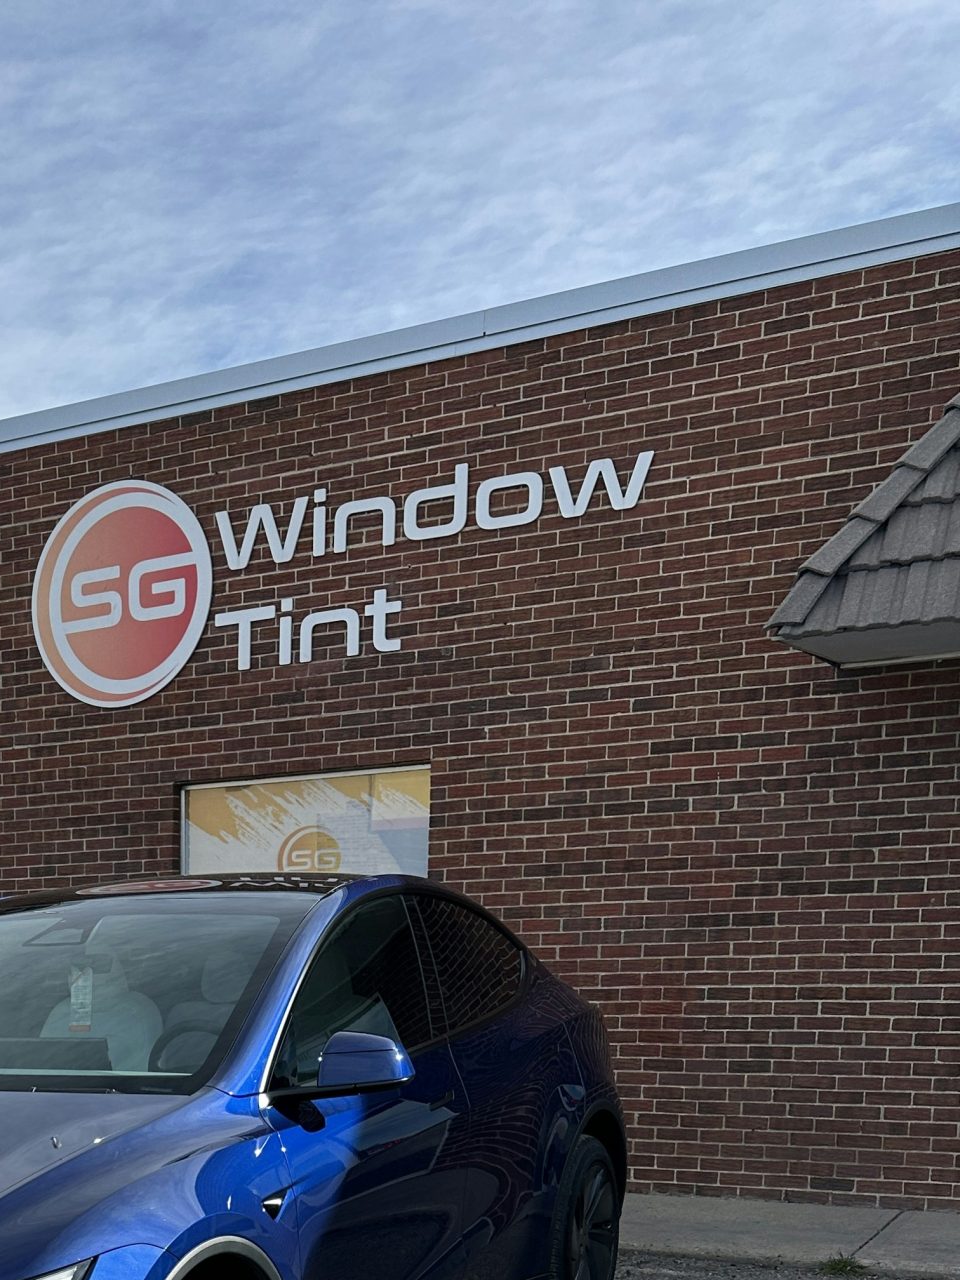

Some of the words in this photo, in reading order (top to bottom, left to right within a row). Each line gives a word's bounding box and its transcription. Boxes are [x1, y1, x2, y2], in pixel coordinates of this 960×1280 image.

[214, 450, 655, 571] Window
[61, 550, 198, 636] SG
[214, 588, 402, 671] Tint
[290, 850, 339, 871] SG
